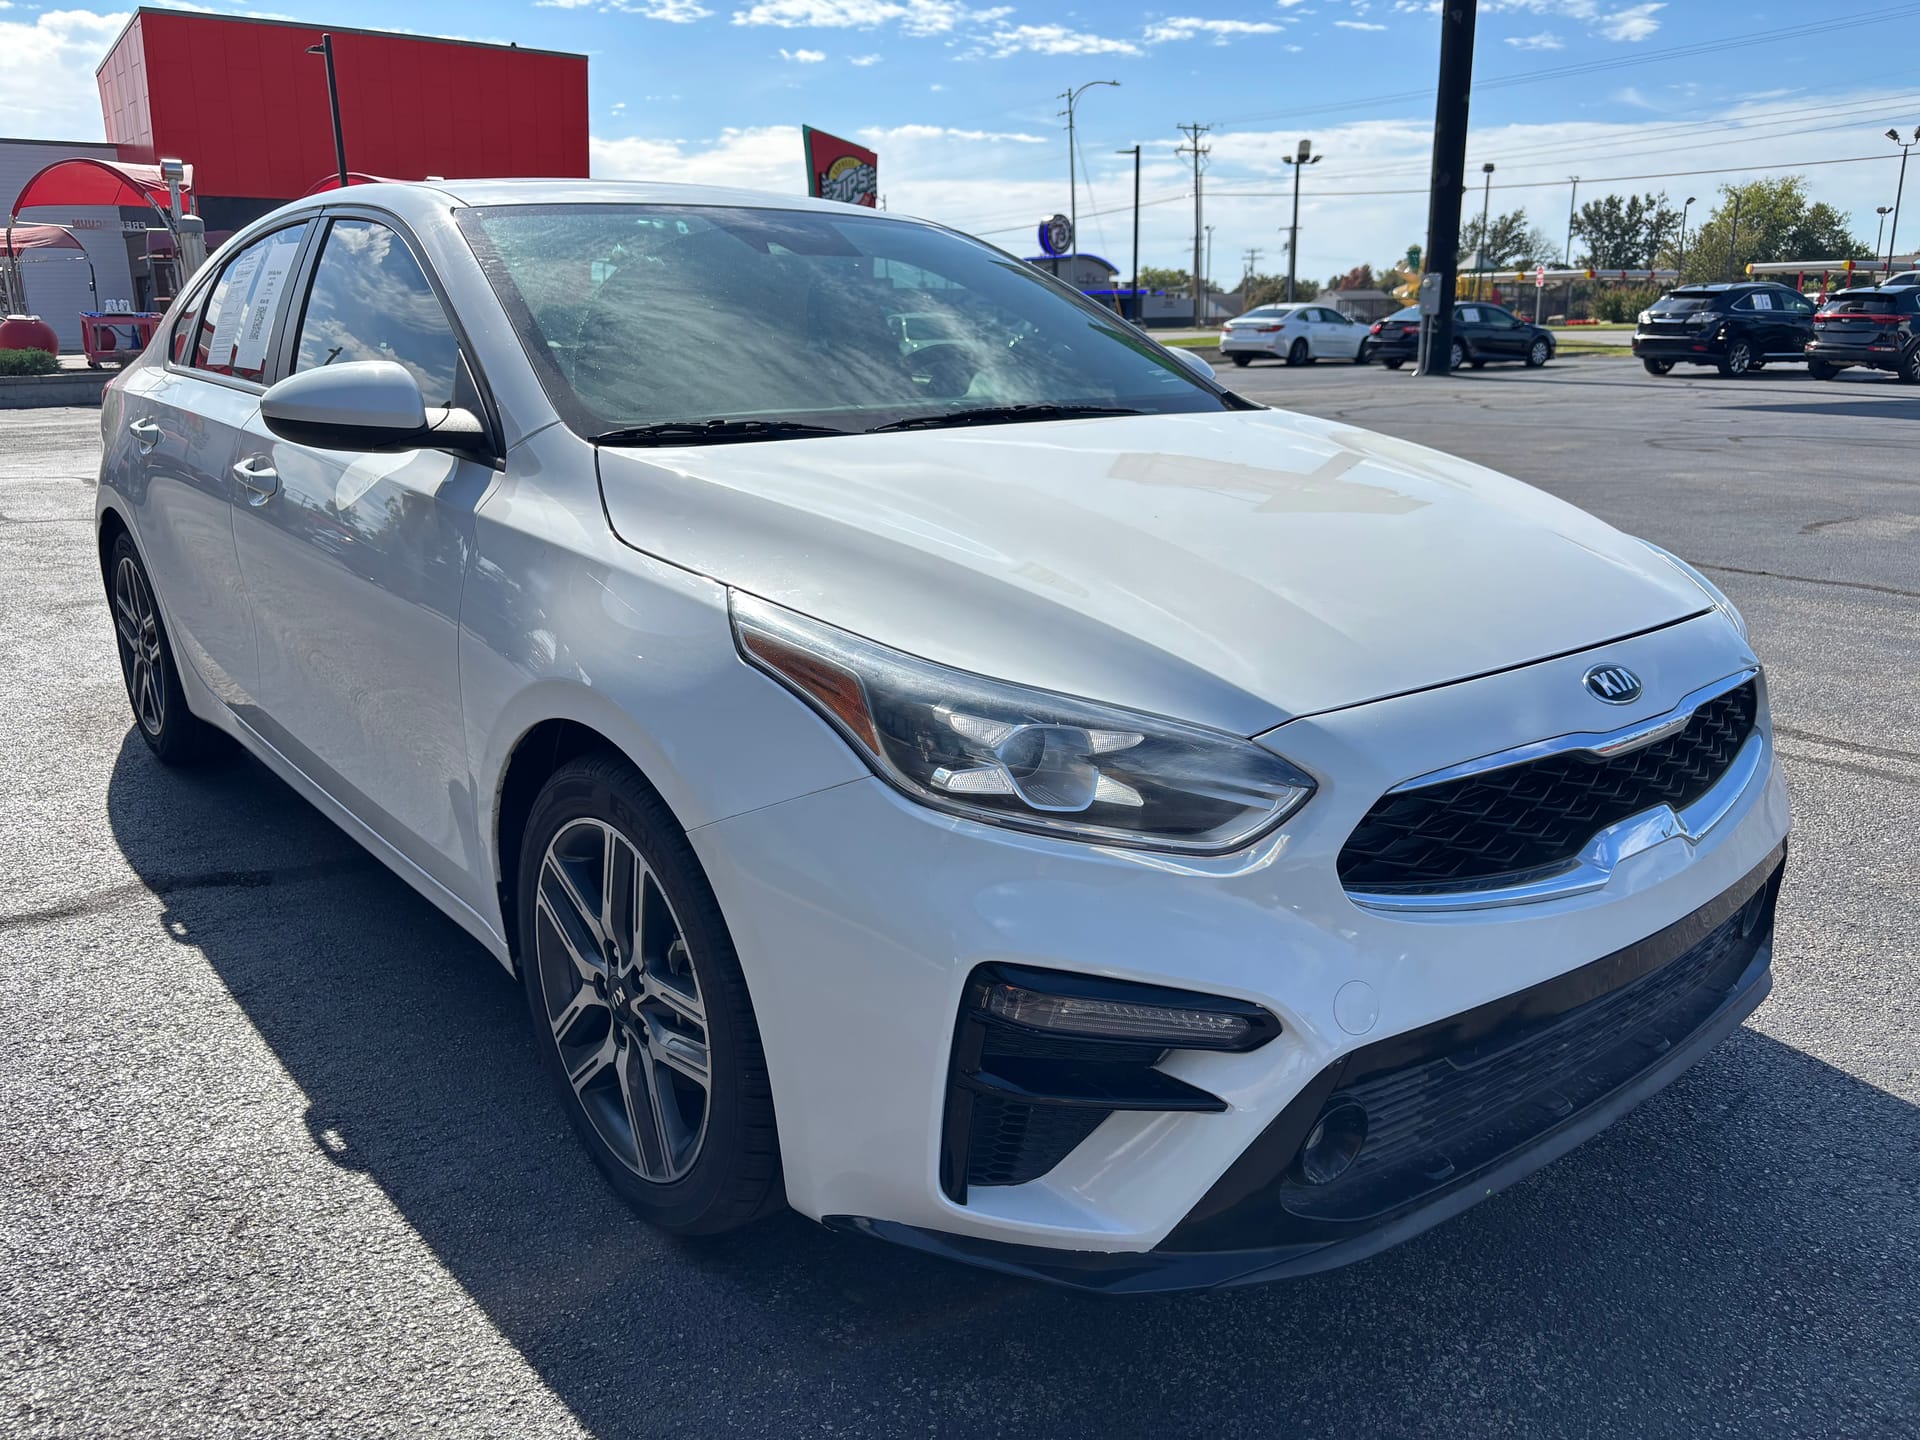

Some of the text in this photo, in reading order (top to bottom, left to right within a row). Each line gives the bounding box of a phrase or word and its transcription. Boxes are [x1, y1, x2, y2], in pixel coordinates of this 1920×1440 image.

[831, 169, 868, 201] ZIPS
[1591, 668, 1640, 697] KIA
[610, 986, 626, 1011] KIA
